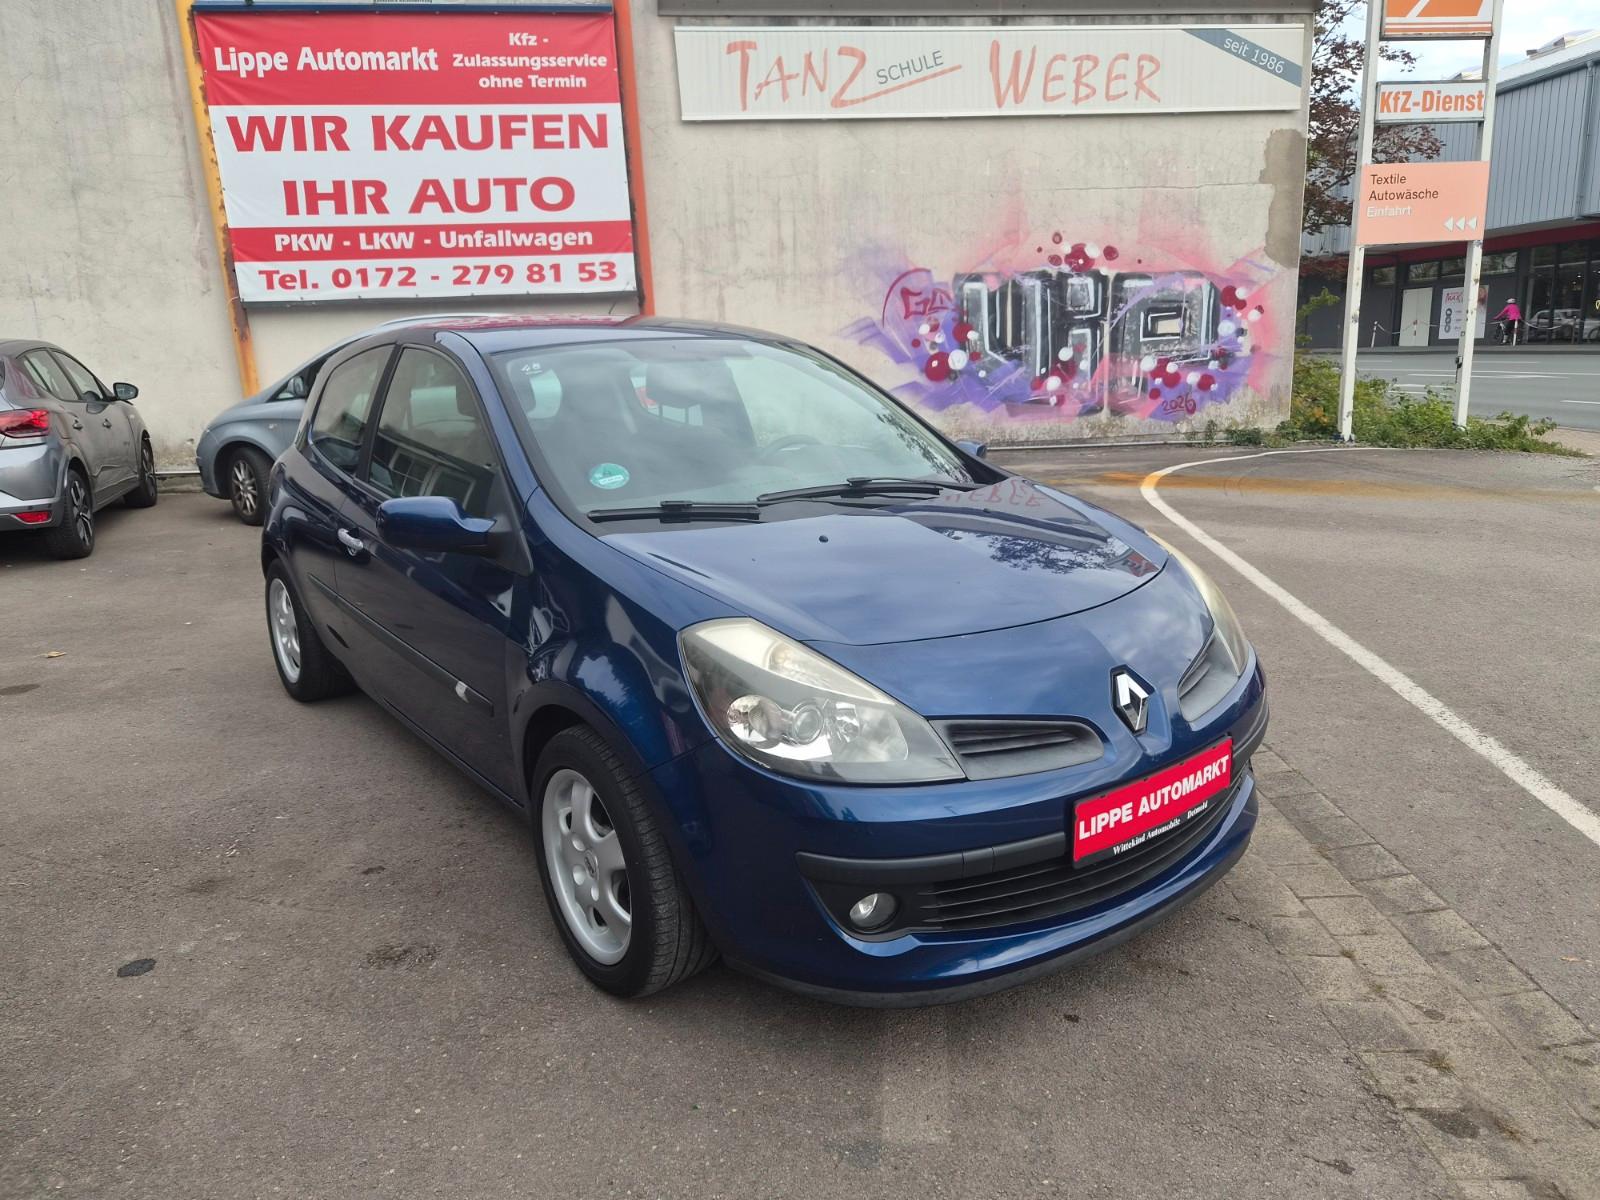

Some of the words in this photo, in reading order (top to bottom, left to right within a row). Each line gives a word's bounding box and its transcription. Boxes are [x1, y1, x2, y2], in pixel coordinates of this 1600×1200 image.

[508, 32, 537, 47] Kfz
[214, 47, 289, 78] Lippe
[297, 47, 439, 72] Automarkt
[452, 53, 608, 70] Zulassungsservice
[876, 50, 944, 84] SCHULE
[1223, 38, 1249, 57] seit
[1251, 49, 1285, 74] 1986
[478, 74, 523, 89] ohne
[527, 74, 587, 89] Termin
[726, 40, 945, 112] TANZ
[989, 39, 1161, 109] WEBER
[225, 115, 350, 153] WIR
[371, 113, 609, 152] KAUFEN
[1371, 174, 1407, 185] Textile
[283, 179, 389, 216] IHR
[408, 176, 576, 214] AUTO
[1369, 189, 1439, 201] Autowäsche
[1366, 205, 1412, 218] Einfahrt
[274, 234, 334, 251] PKW
[359, 232, 415, 250] LKW
[439, 229, 593, 251] Unfallwagen
[258, 269, 319, 290] Tel.
[331, 266, 417, 288] 0172
[452, 263, 515, 286] 279
[526, 263, 562, 284] 81
[577, 261, 617, 282] 53
[1079, 802, 1133, 840] LIPPE
[1137, 755, 1230, 817] AUTOMARKT
[1112, 833, 1146, 855] Wittekind
[1146, 817, 1181, 840] Automobile
